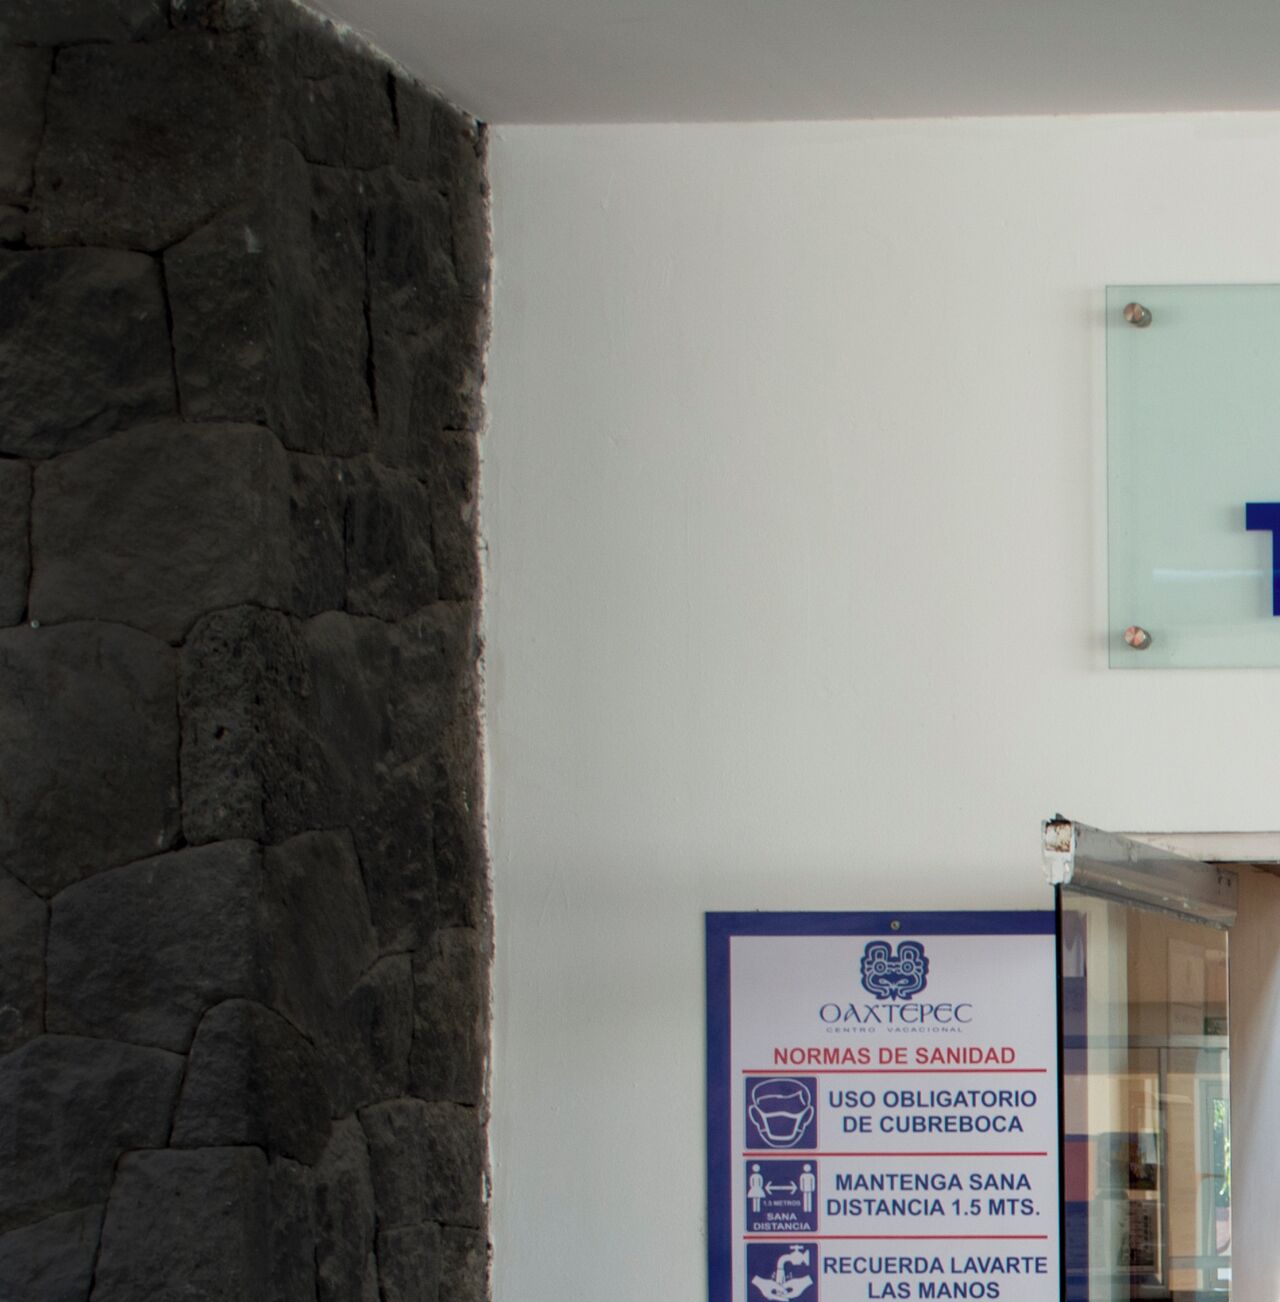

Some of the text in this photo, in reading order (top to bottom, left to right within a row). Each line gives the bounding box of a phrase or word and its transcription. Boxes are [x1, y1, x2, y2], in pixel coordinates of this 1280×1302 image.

[820, 1004, 971, 1023] OAXTEPEC
[774, 1047, 1015, 1065] NORMAS DE SANIDAD
[830, 1090, 1037, 1108] USO OBLIGATORIO
[844, 1116, 1023, 1133] DE CUBREBOCA
[836, 1174, 1031, 1190] MANTENGA SANA
[827, 1199, 1039, 1216] DISTANCIA 1.5 MTS.
[766, 1212, 797, 1221] SANA
[753, 1222, 811, 1231] DISTANCIA
[824, 1257, 1047, 1274] RECUERDA LAVARTE
[869, 1282, 999, 1299] LAS MANOS
